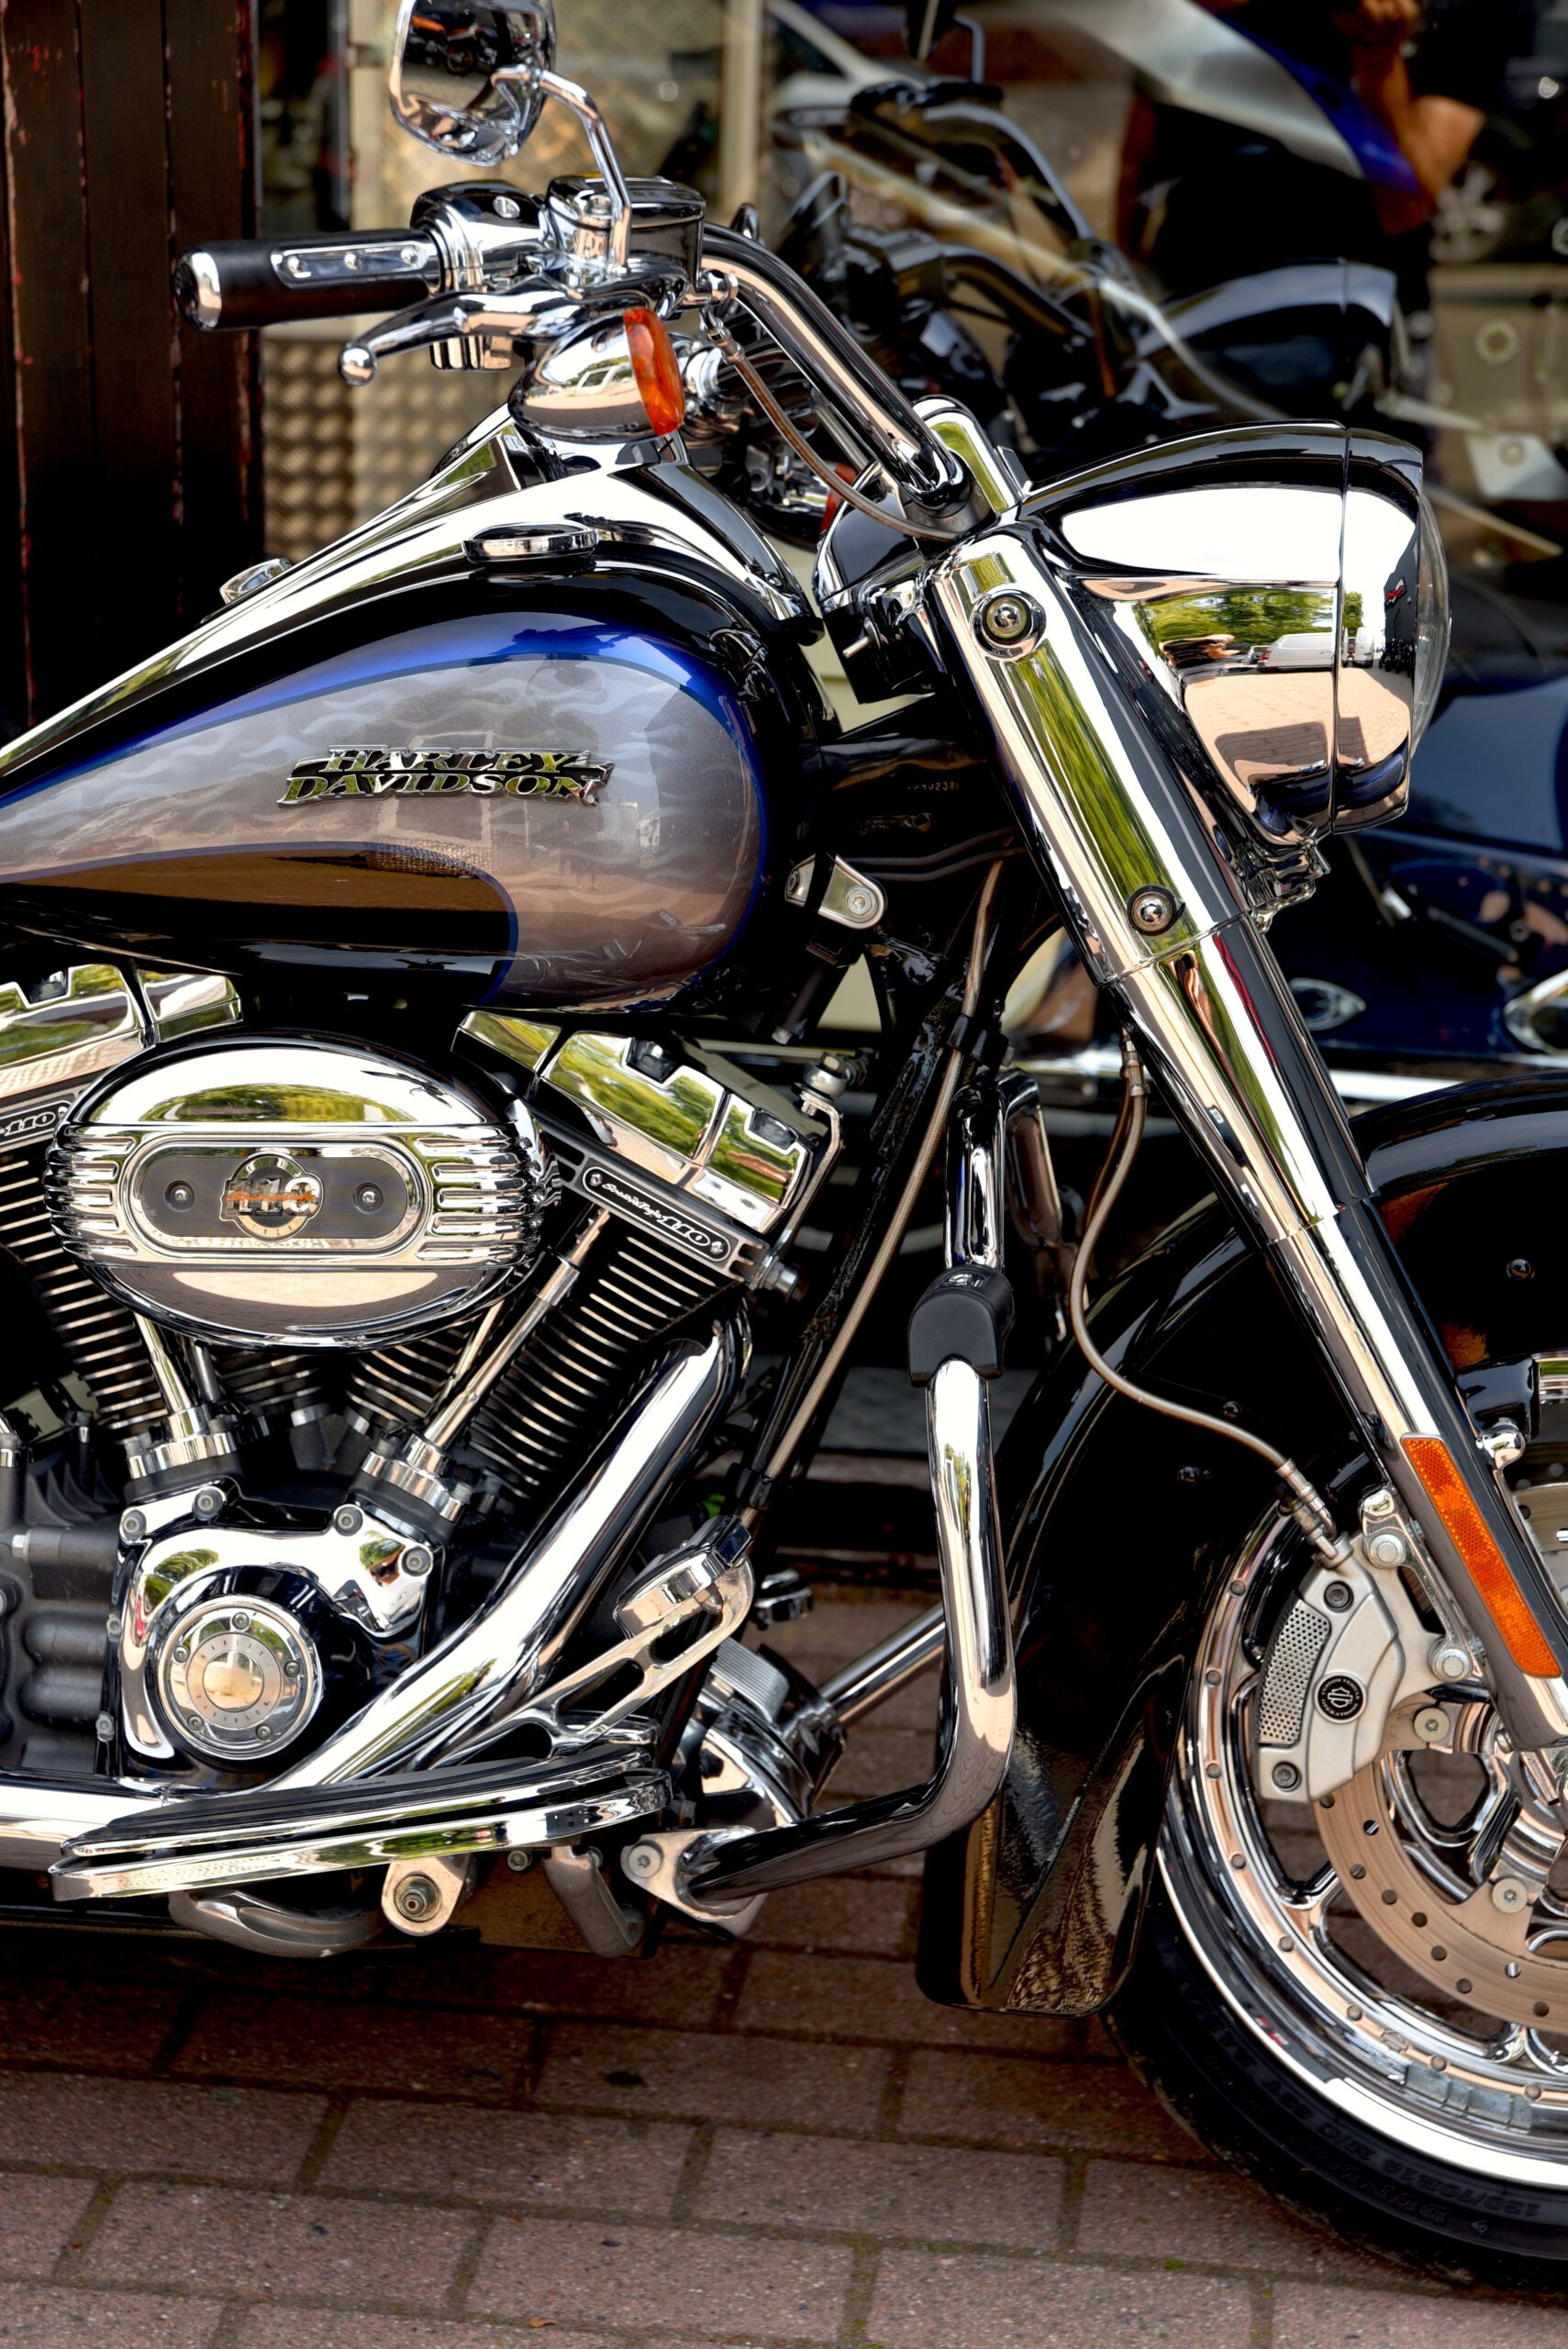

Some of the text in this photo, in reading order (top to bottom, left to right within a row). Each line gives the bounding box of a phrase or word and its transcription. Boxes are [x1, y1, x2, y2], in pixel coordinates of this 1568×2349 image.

[318, 747, 580, 773] HARLEY
[277, 773, 598, 806] DAVIDSON
[4, 1111, 56, 1137] 110
[656, 1215, 711, 1246] 110
